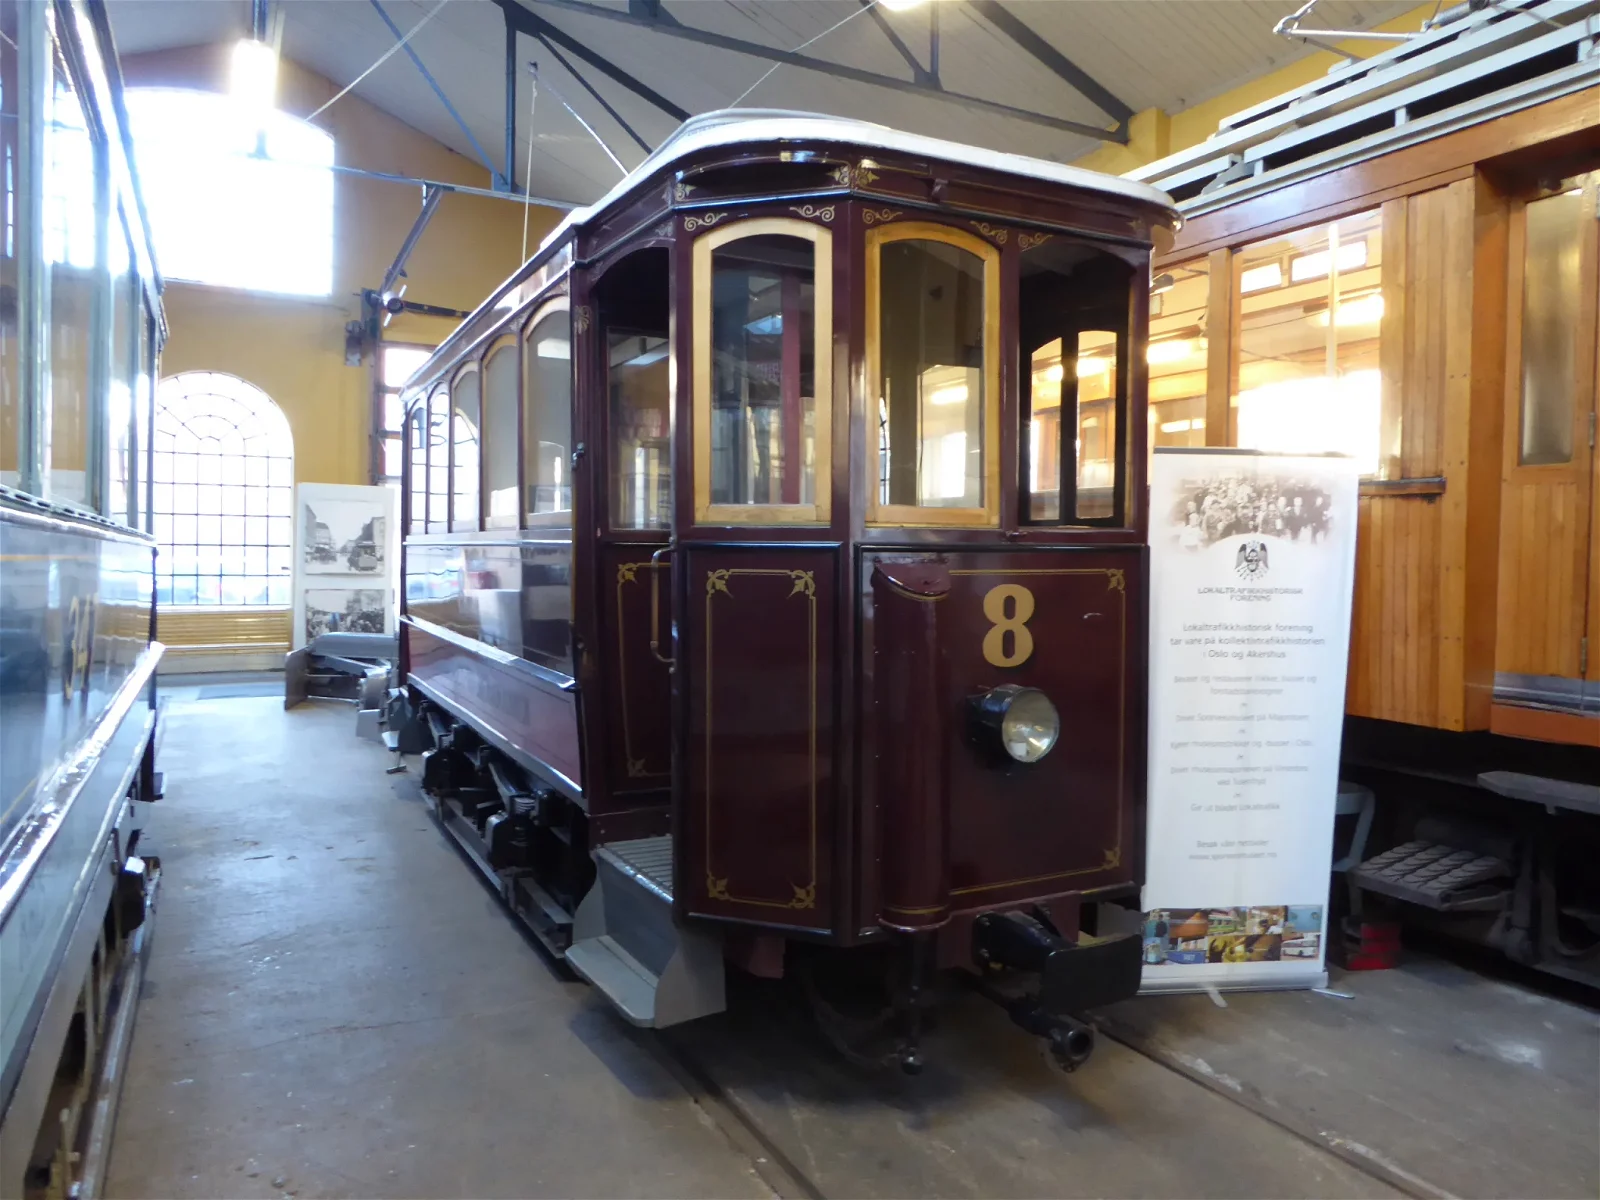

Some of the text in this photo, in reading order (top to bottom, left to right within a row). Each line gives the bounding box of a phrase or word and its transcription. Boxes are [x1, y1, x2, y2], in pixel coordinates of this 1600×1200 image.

[982, 583, 1035, 668] 8
[1275, 624, 1314, 634] forening
[1208, 649, 1228, 658] Oslo
[1231, 651, 1244, 660] og
[1246, 649, 1286, 658] Akershus
